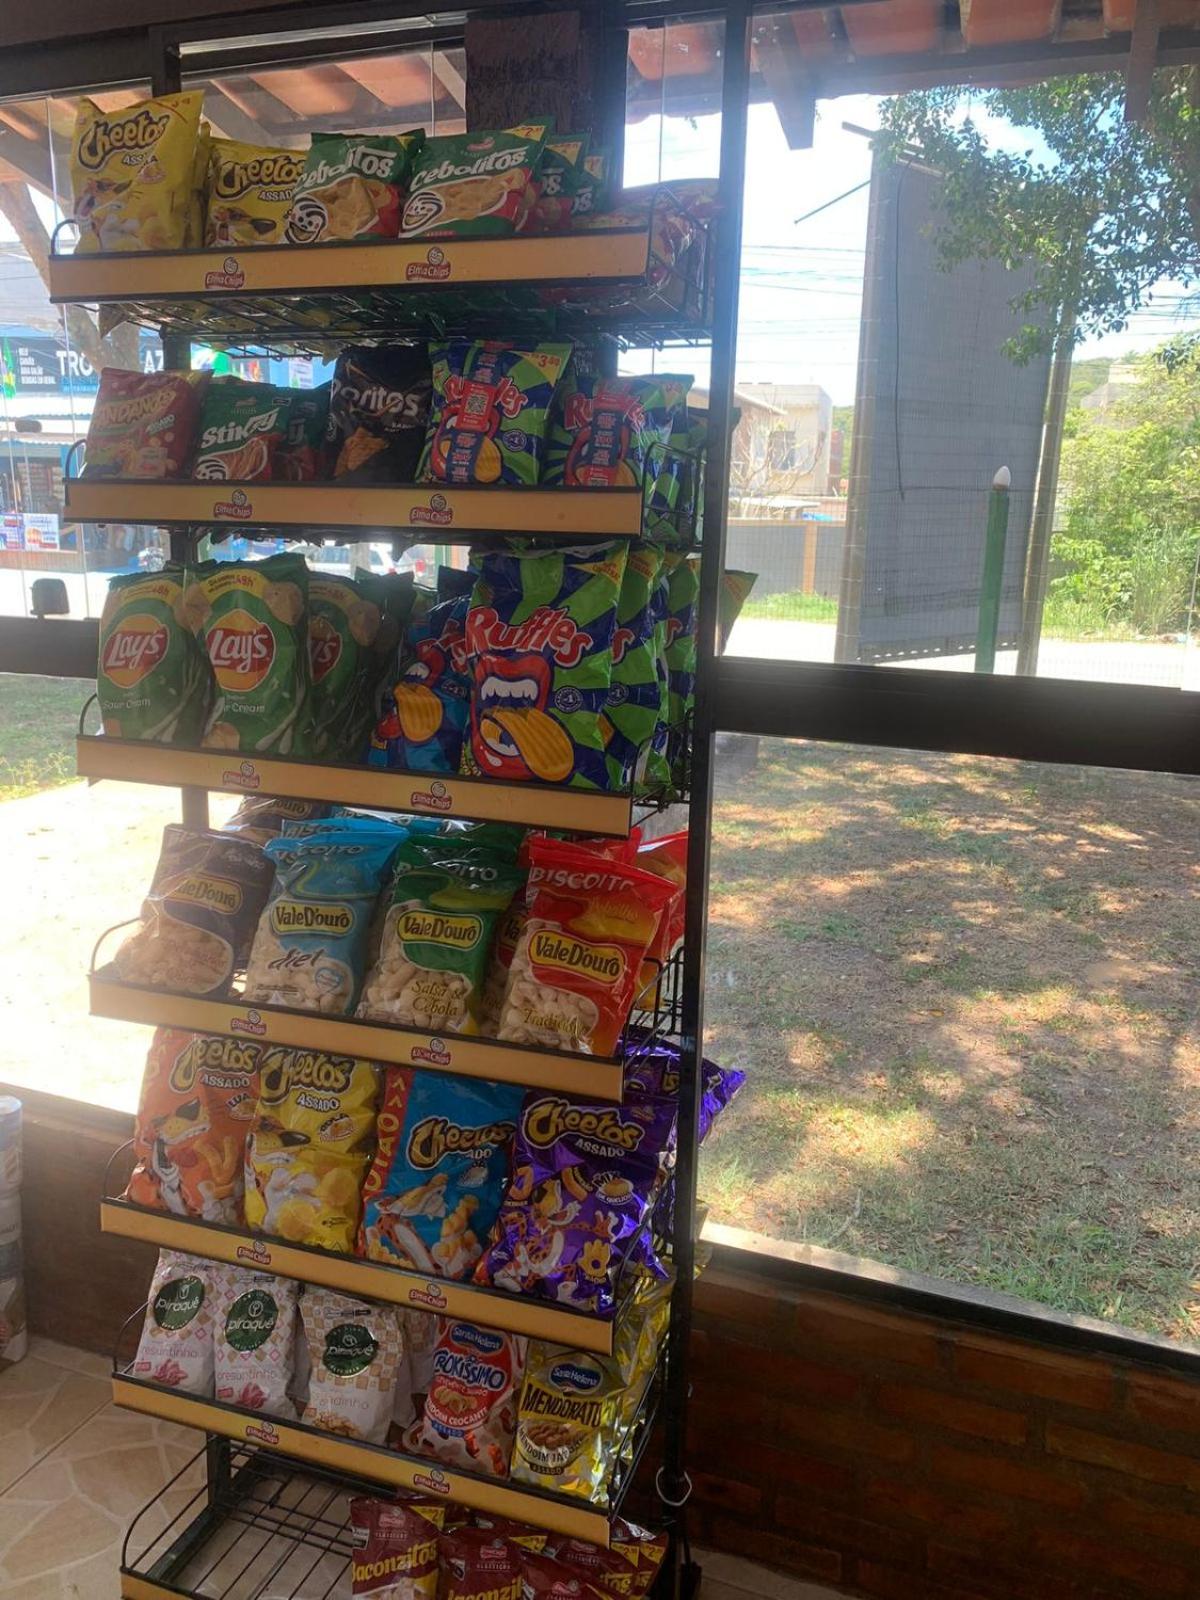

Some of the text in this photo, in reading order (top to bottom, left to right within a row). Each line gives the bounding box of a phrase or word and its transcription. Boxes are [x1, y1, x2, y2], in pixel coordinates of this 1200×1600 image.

[79, 111, 169, 169] Cheetos
[410, 146, 529, 192] Cebolitos
[259, 190, 295, 201] ASSAD
[106, 629, 166, 670] Lay's
[209, 626, 269, 673] Lay's
[465, 605, 593, 667] Ruffles
[201, 1073, 250, 1087] ASSADO
[297, 1093, 341, 1111] ASSADO
[525, 1101, 643, 1149] Cheetos
[574, 1138, 625, 1157] ASSADO
[228, 1317, 274, 1333] piraquê
